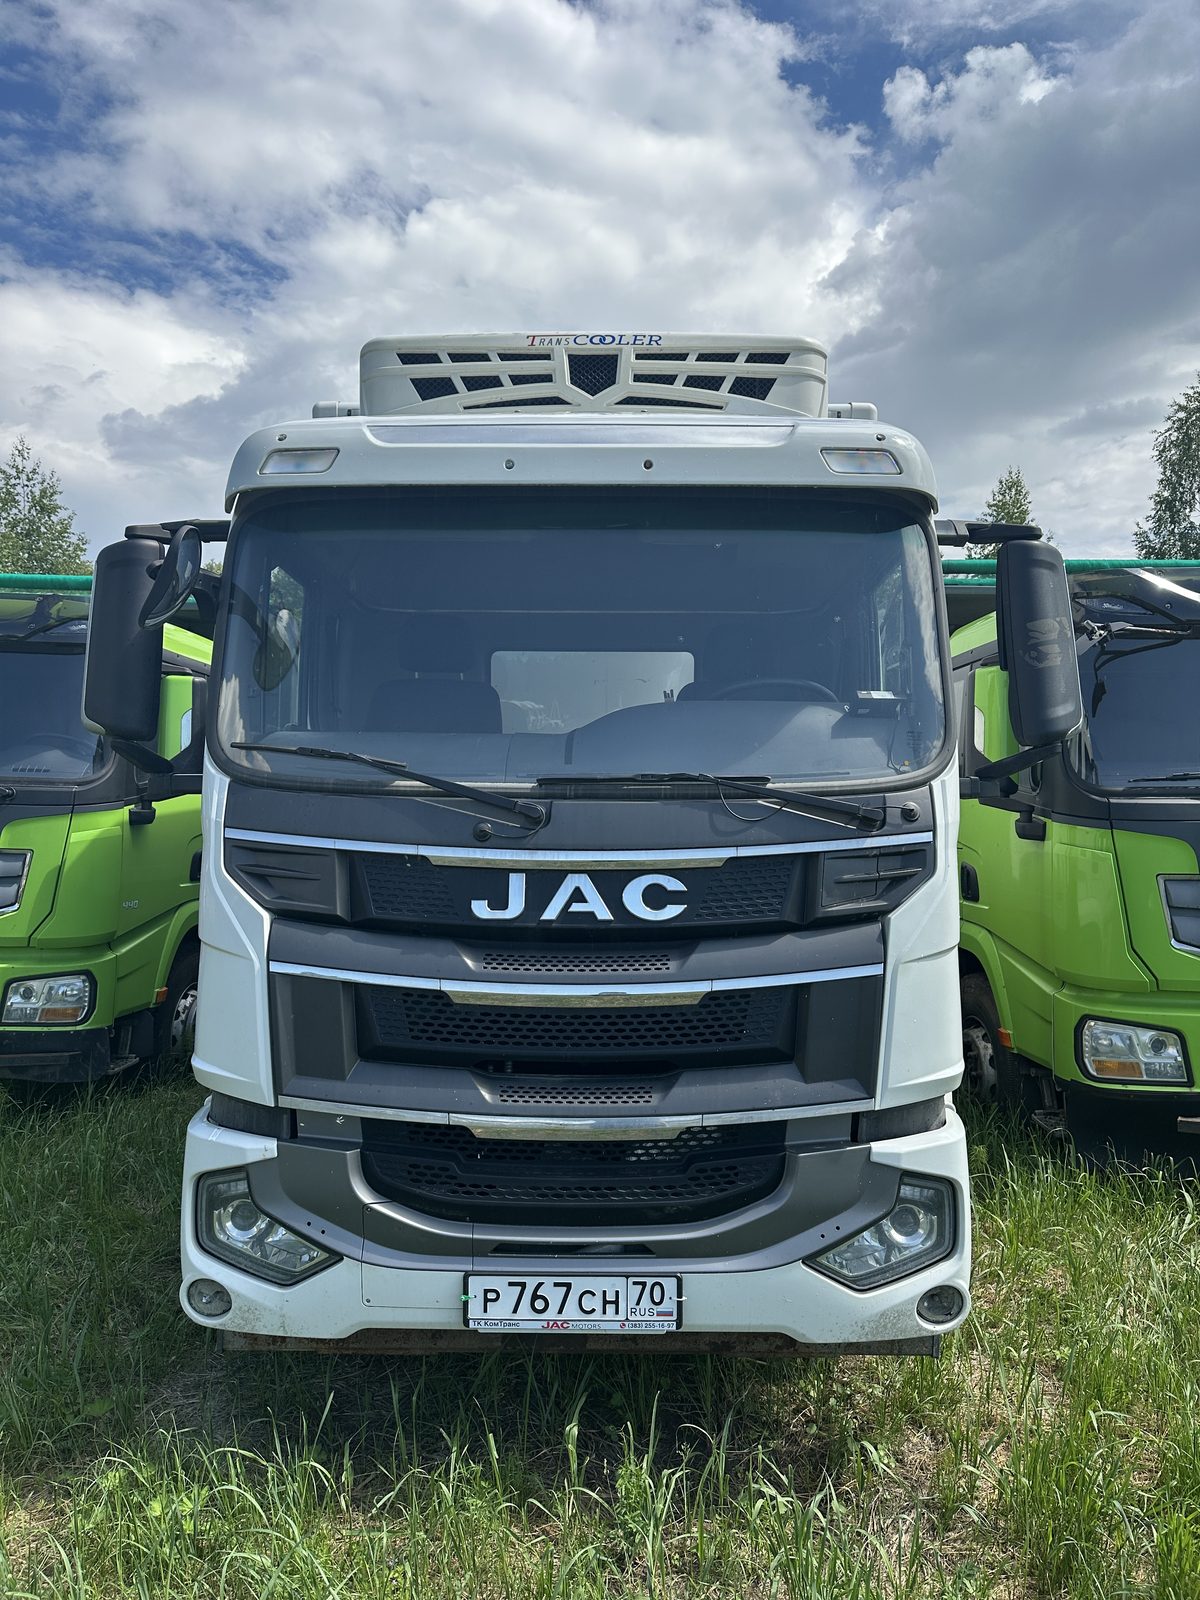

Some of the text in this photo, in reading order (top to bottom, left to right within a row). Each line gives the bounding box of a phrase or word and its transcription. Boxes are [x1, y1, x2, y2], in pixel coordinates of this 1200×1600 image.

[471, 872, 688, 921] JAC
[632, 1280, 666, 1306] 70
[630, 1307, 655, 1317] RUS
[484, 1320, 521, 1328] КомТранс
[541, 1321, 602, 1330] JAC MOTORS
[644, 1321, 675, 1329] 255-16-97
